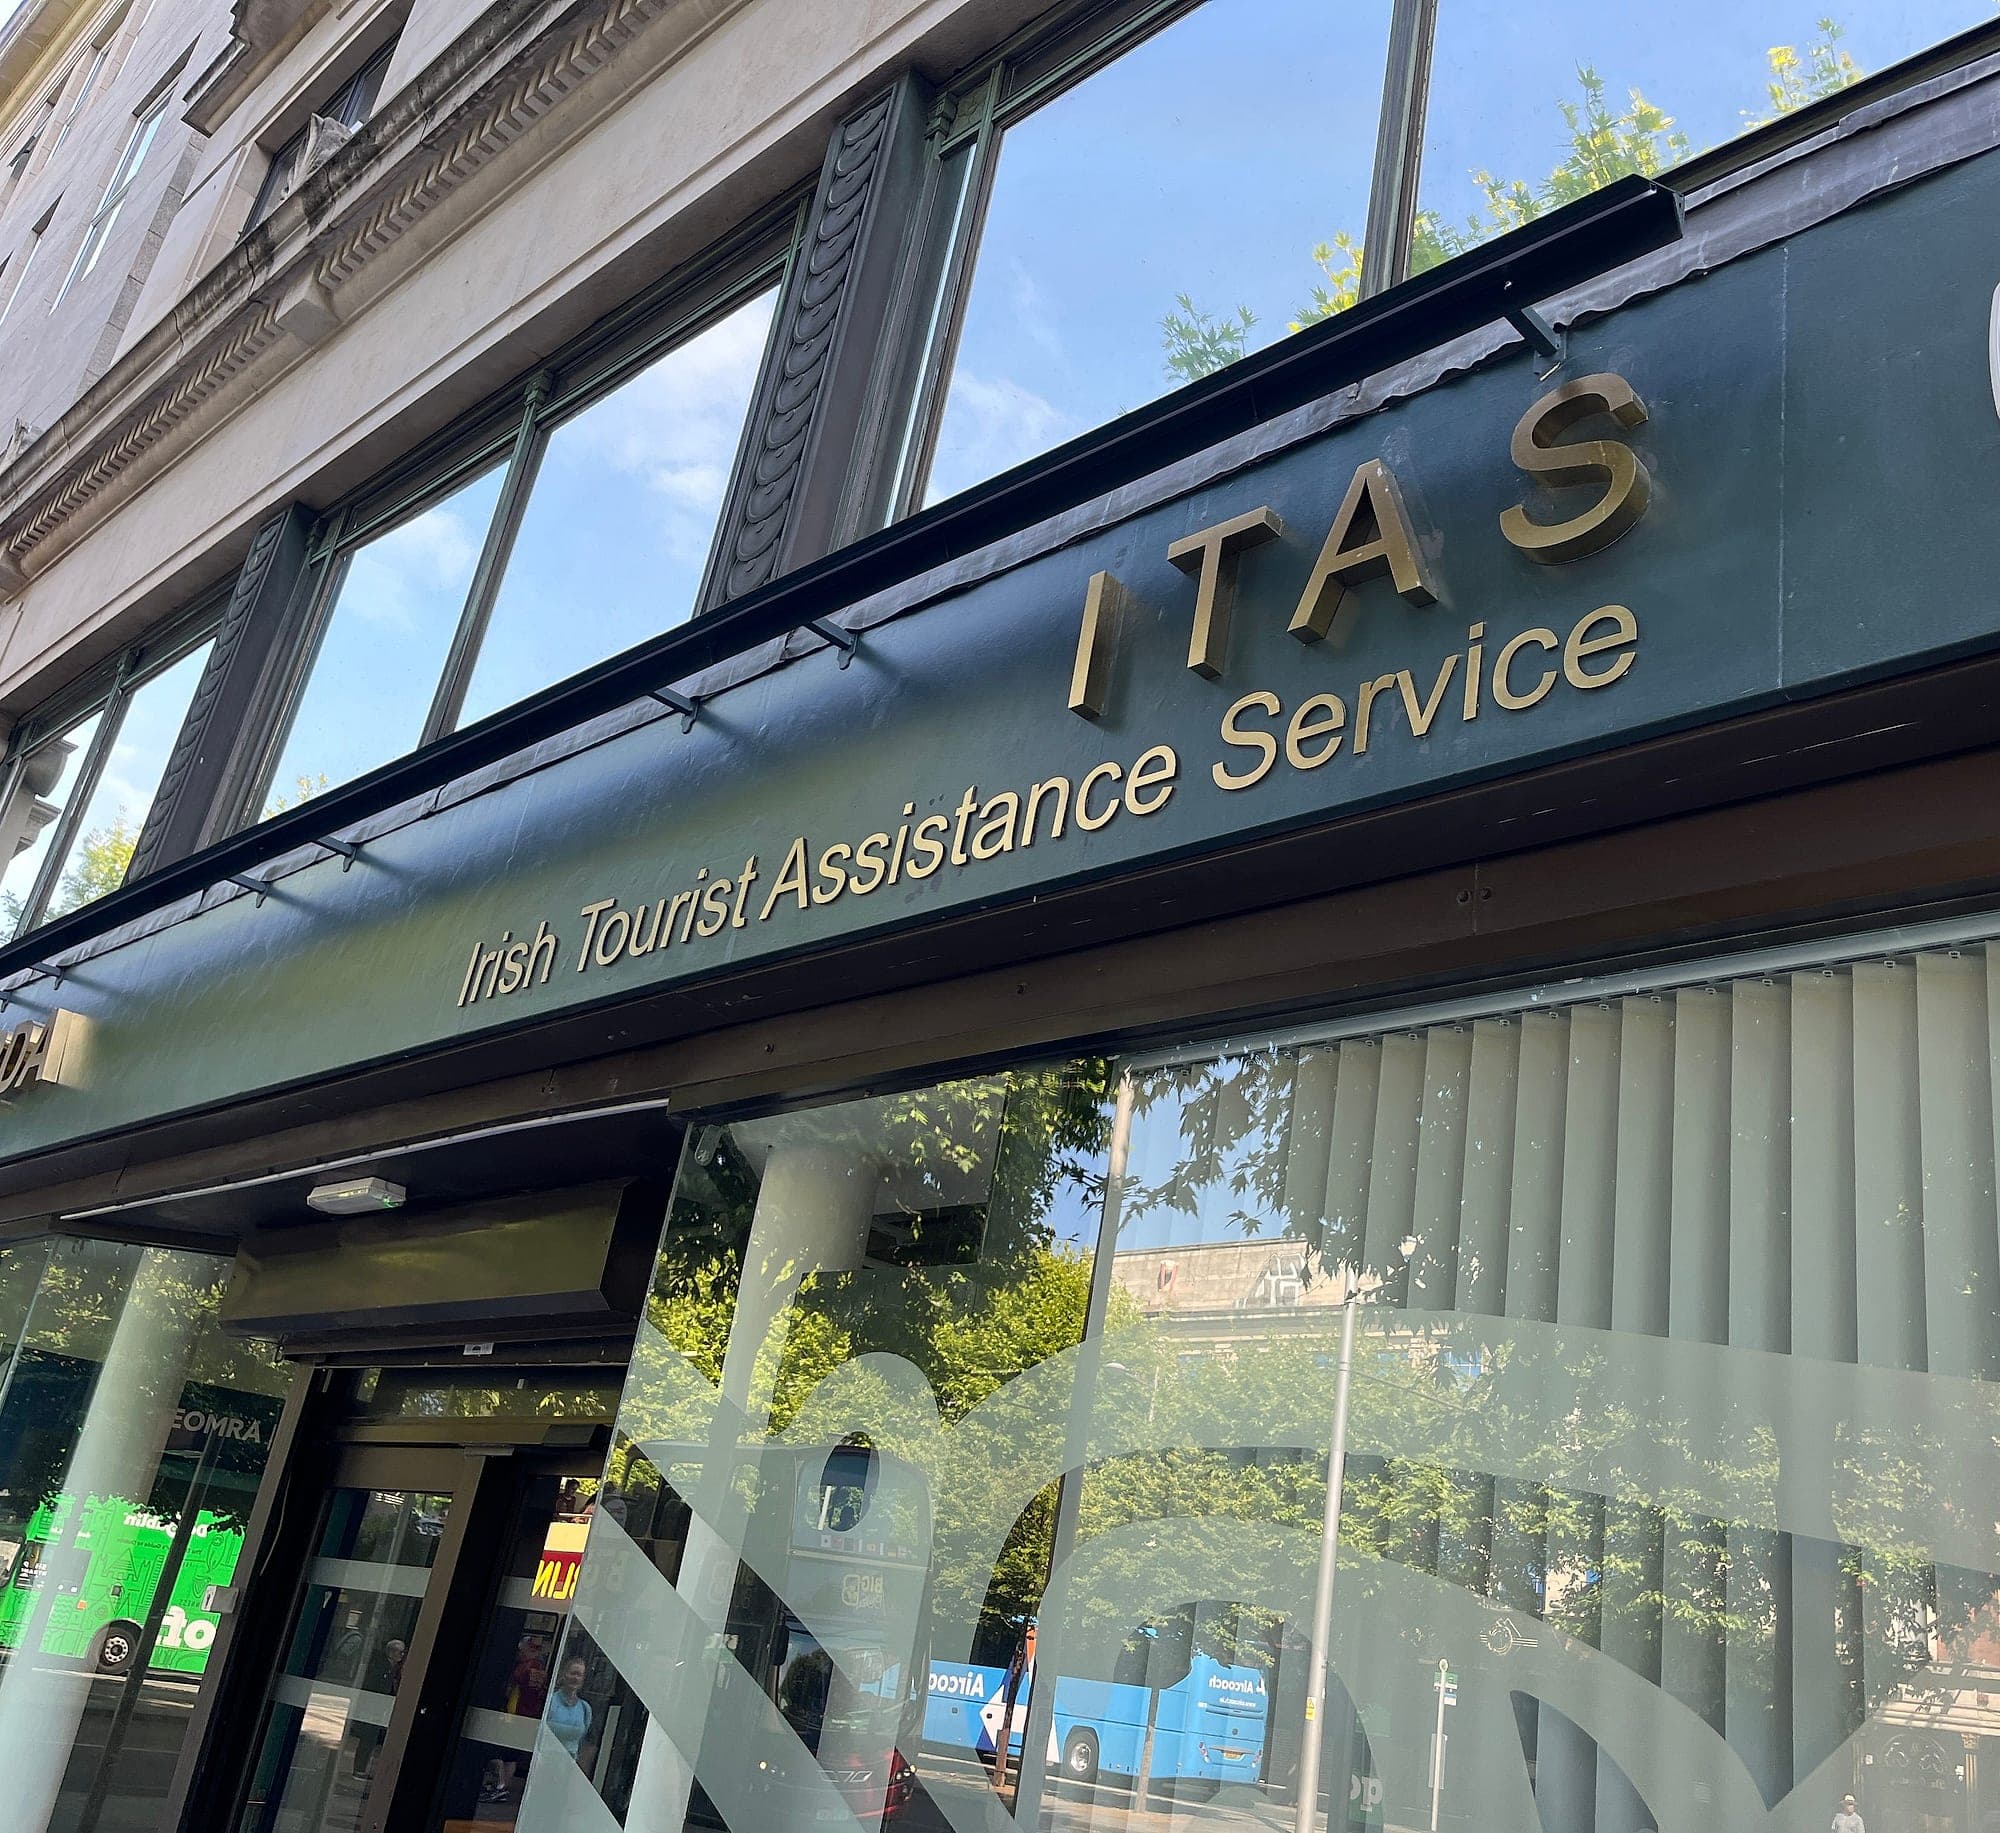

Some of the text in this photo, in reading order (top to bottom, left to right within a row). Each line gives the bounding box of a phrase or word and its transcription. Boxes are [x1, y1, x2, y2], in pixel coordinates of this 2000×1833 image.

[457, 604, 1638, 1007] Irish Tourist Assistance Service
